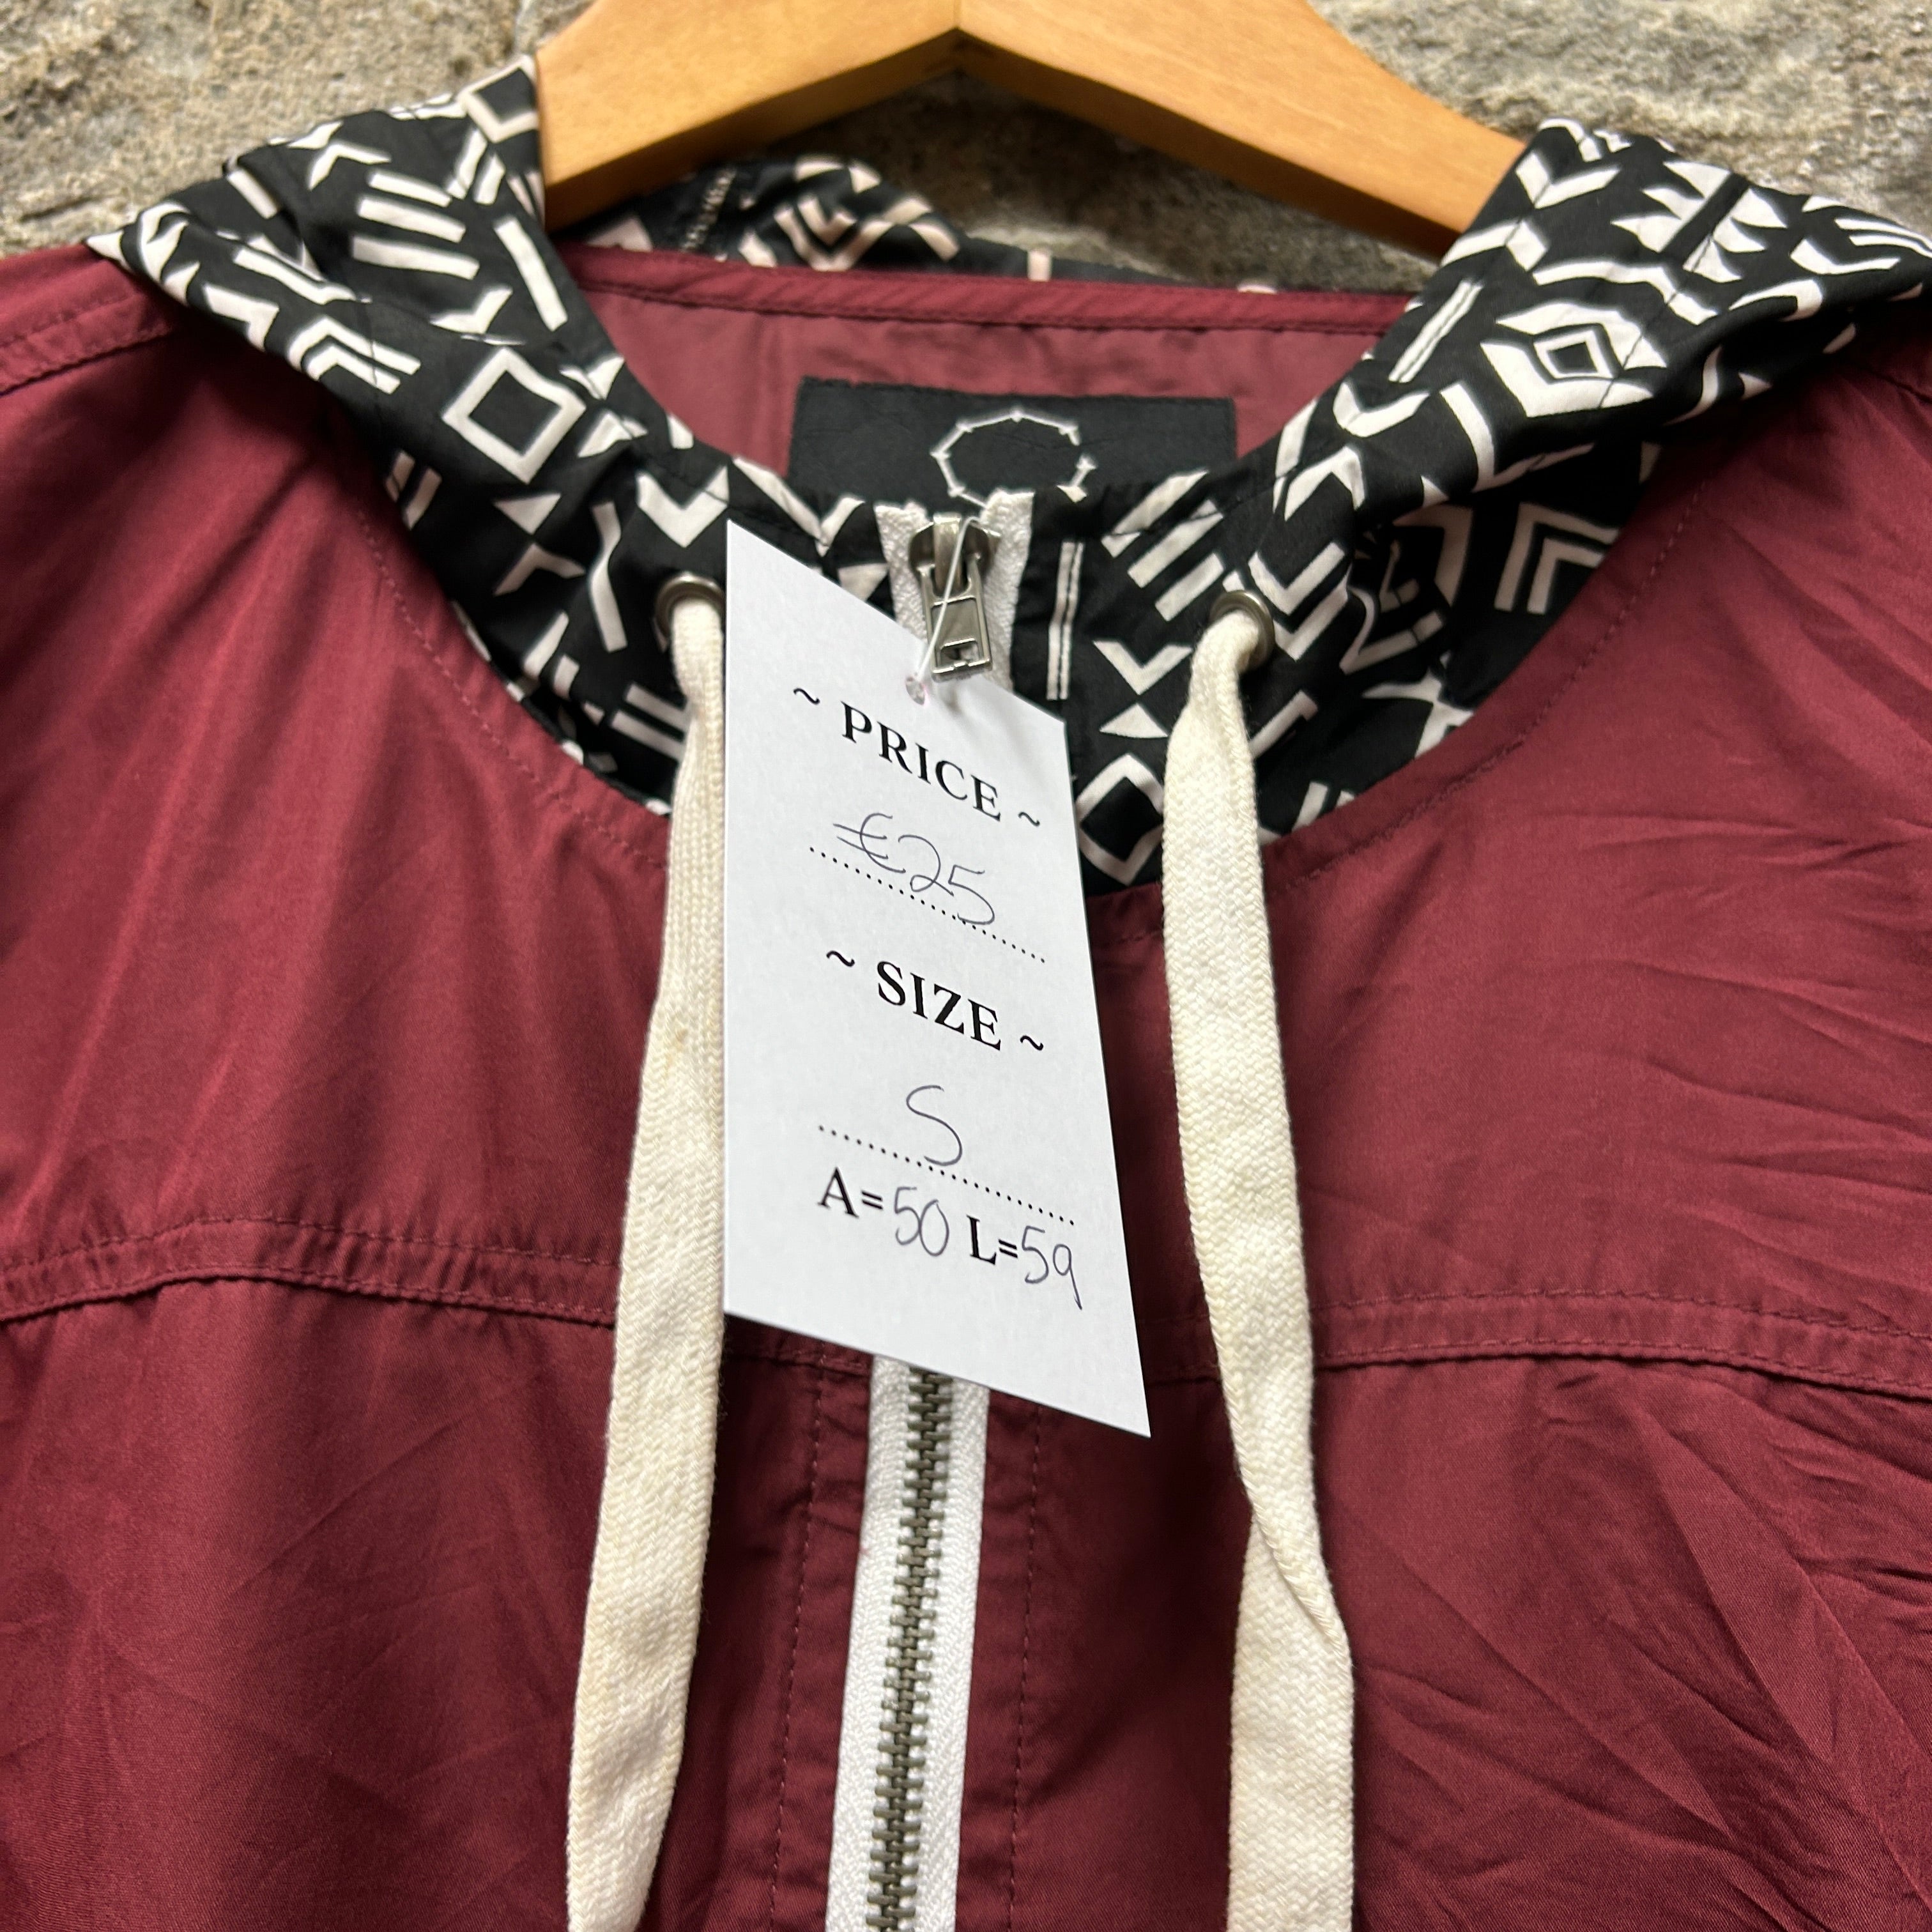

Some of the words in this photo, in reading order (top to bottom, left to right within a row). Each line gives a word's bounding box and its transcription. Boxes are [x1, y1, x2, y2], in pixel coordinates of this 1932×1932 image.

[841, 701, 1001, 822] PRICE
[832, 812, 995, 925] €25
[876, 960, 1002, 1051] SIZE
[905, 1084, 963, 1167] S
[817, 1167, 950, 1257] A=50
[966, 1214, 1083, 1310] L=59
